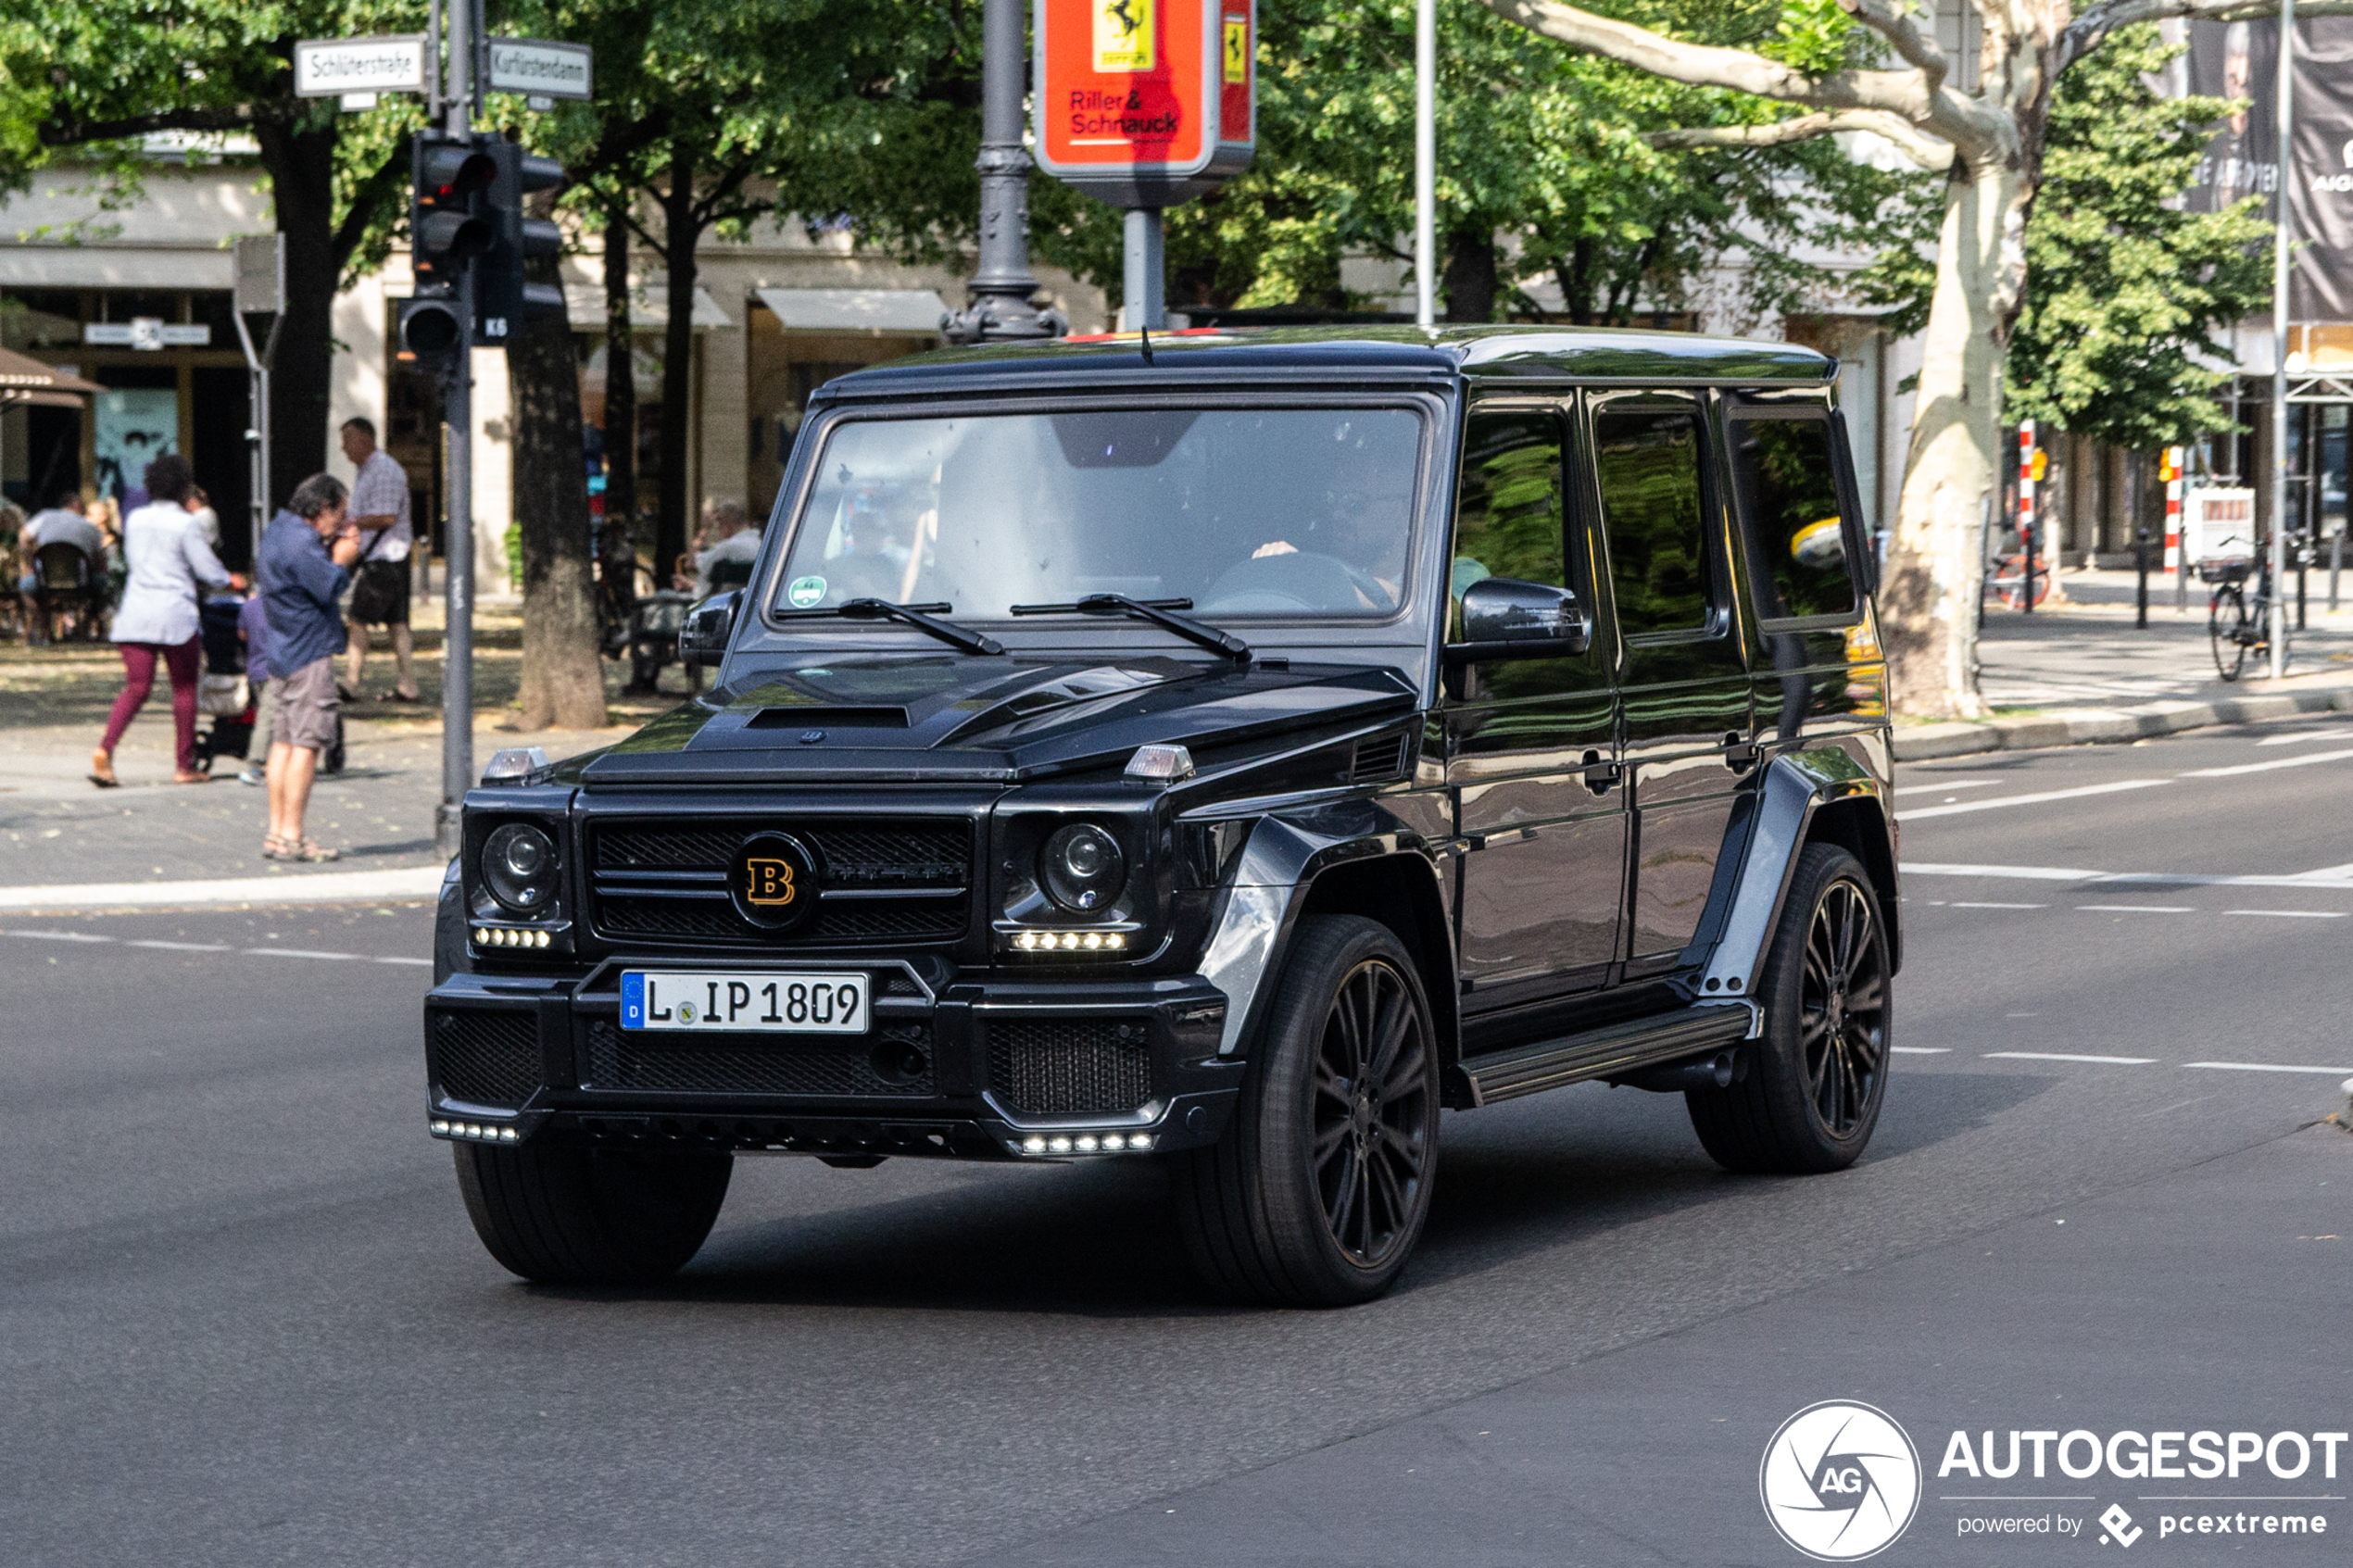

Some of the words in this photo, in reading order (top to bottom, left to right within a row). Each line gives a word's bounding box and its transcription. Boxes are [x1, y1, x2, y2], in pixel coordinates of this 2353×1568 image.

[311, 51, 412, 78] Schlüterstraße
[495, 51, 584, 81] Kurfürstendamm
[1071, 91, 1122, 110] Riller
[1126, 90, 1141, 110] &
[1071, 112, 1177, 134] Schnauck
[2310, 173, 2353, 193] AIG
[748, 858, 795, 906] B
[629, 1005, 638, 1018] D
[648, 981, 672, 1022] L
